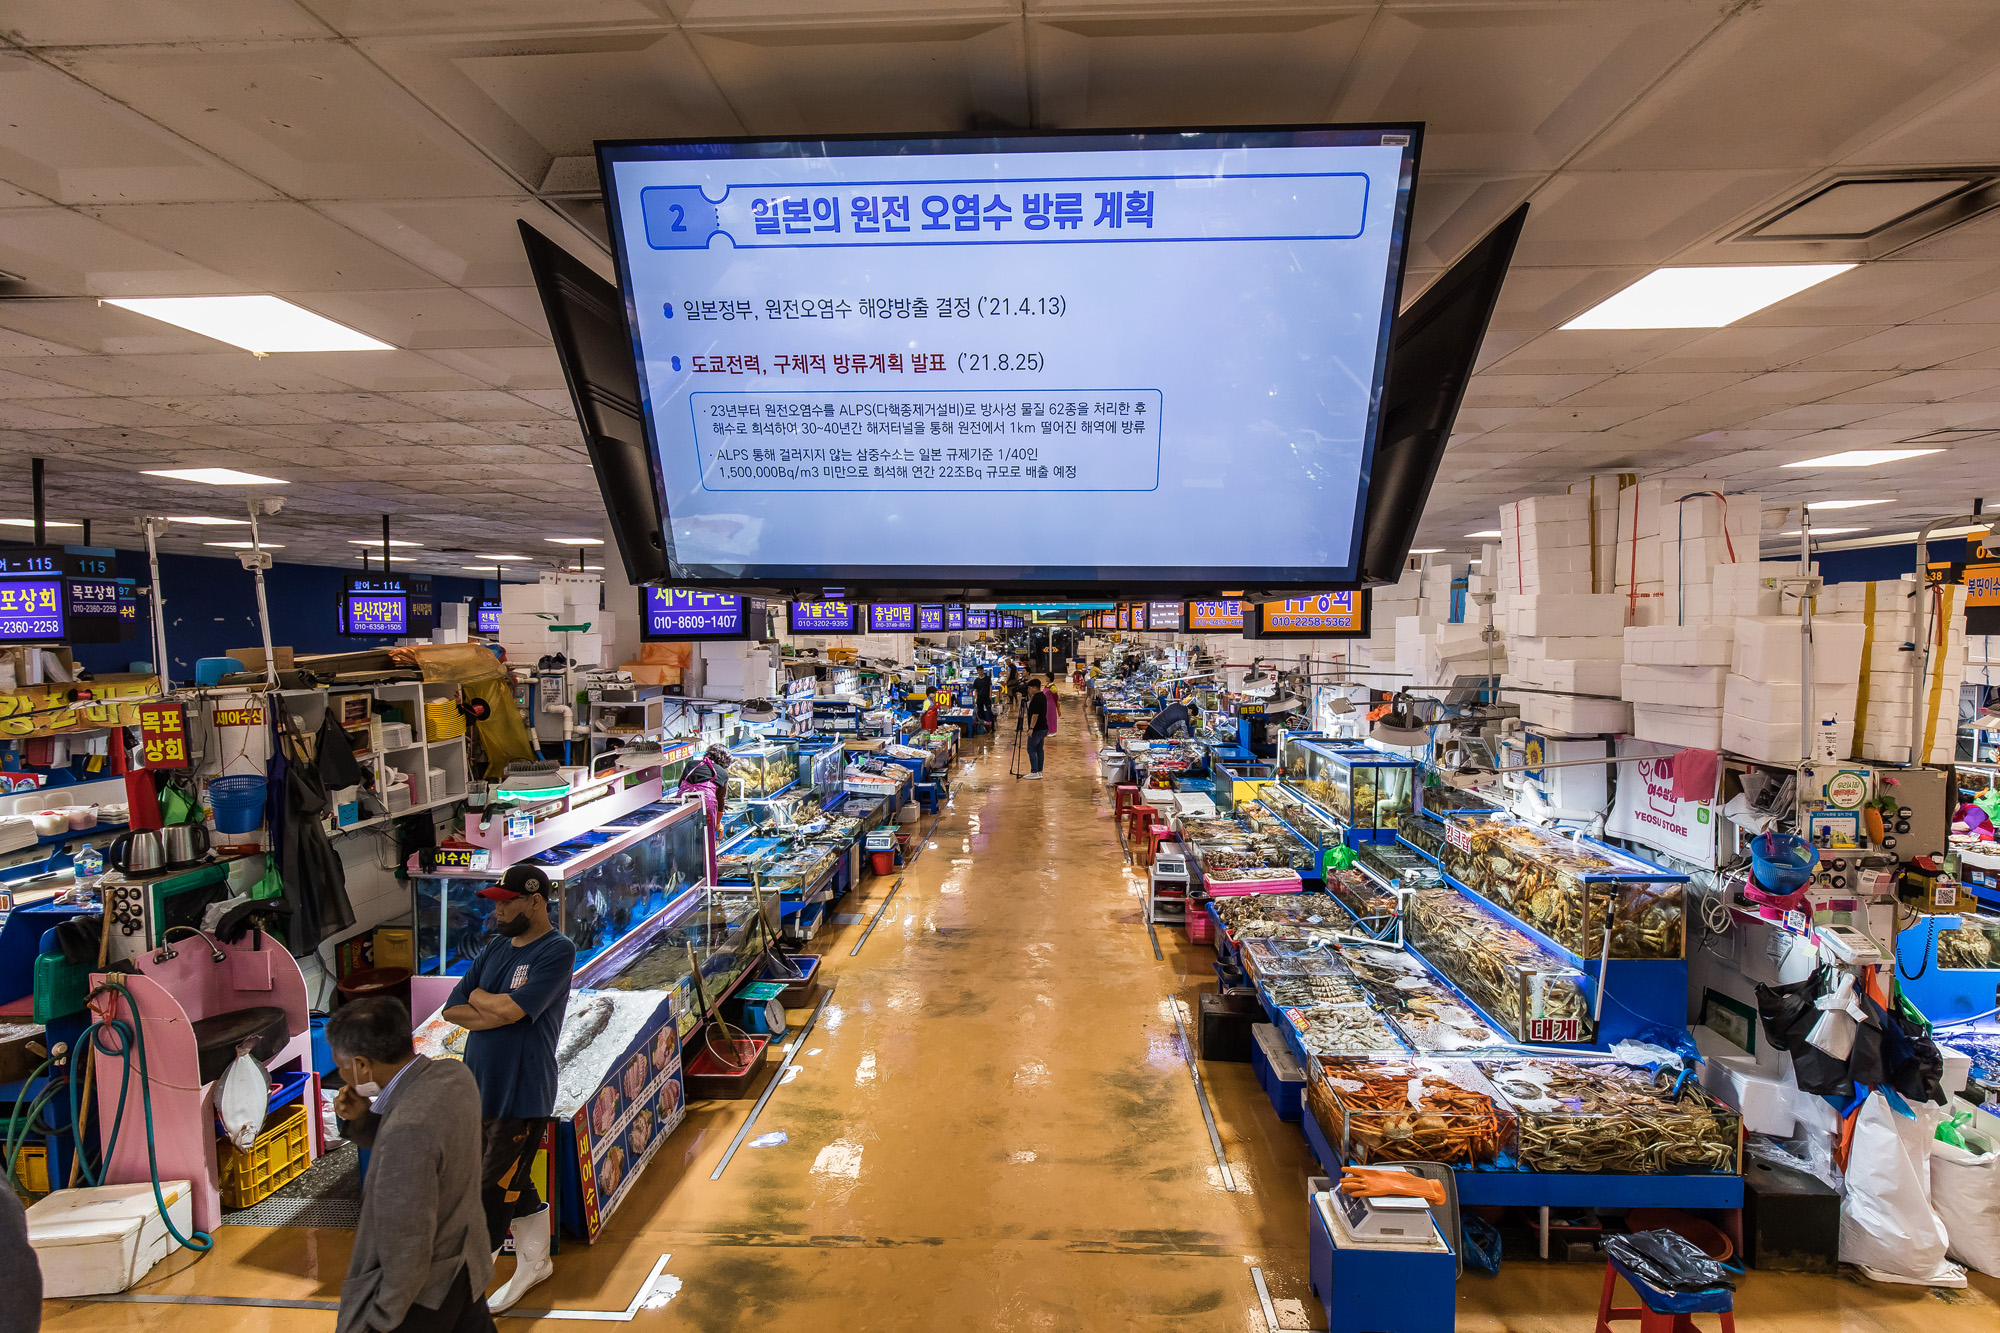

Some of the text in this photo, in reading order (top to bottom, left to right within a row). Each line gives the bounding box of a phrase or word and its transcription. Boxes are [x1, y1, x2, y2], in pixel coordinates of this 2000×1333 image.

[669, 204, 687, 232] 2
[752, 191, 1154, 234] 일본의 원전 오염수 방류 계획
[684, 295, 1065, 320] 일본정부, 원전오염수 해양방출 결정 ('21.4.13)
[692, 352, 1043, 375] 도쿄전력, 구체적 방류계획 발표 ('21.8.25)
[711, 405, 760, 417] 23년부터
[765, 404, 835, 417] 원전오염수를
[981, 403, 1016, 416] 방사성
[1021, 403, 1044, 416] 물질
[1050, 402, 1089, 416] 62종을
[1094, 402, 1130, 415] 처리한
[1134, 402, 1146, 415] 후
[713, 421, 1145, 435] 해수로 희석하여 30~40년간 해저터널을 통해 원전에서 1km 떨어진 해역에 방류
[718, 448, 1037, 461] ALPS 통해 걸러지지 않는 삼중수소는 일본 규제기준 1/40인
[824, 466, 869, 478] 미만으로
[874, 466, 907, 478] 희석해
[912, 466, 935, 478] 연간
[939, 466, 981, 479] 22조Bq
[986, 466, 1021, 478] 규모로
[1026, 465, 1048, 478] 배출
[1053, 466, 1076, 478] 예정
[27, 557, 53, 571] 115
[79, 560, 106, 574] 115
[72, 585, 116, 601] 목포상회
[383, 581, 400, 590] 114
[73, 604, 117, 614] 010-2360-2258
[354, 601, 402, 621] 부산자갈치
[875, 606, 911, 622] 충남미림
[654, 615, 738, 630] 010-8609-1407
[798, 620, 849, 628] 010-3202-9395
[1272, 616, 1351, 628] 010-2258-5362
[142, 710, 182, 734] 목포
[216, 710, 262, 726] 세아수산
[145, 738, 184, 762] 상회
[1634, 810, 1688, 838] YEOSU STORE
[1446, 825, 1472, 854] 킹크랩
[1530, 1018, 1579, 1042] 대게
[580, 1132, 600, 1236] 세아수산
